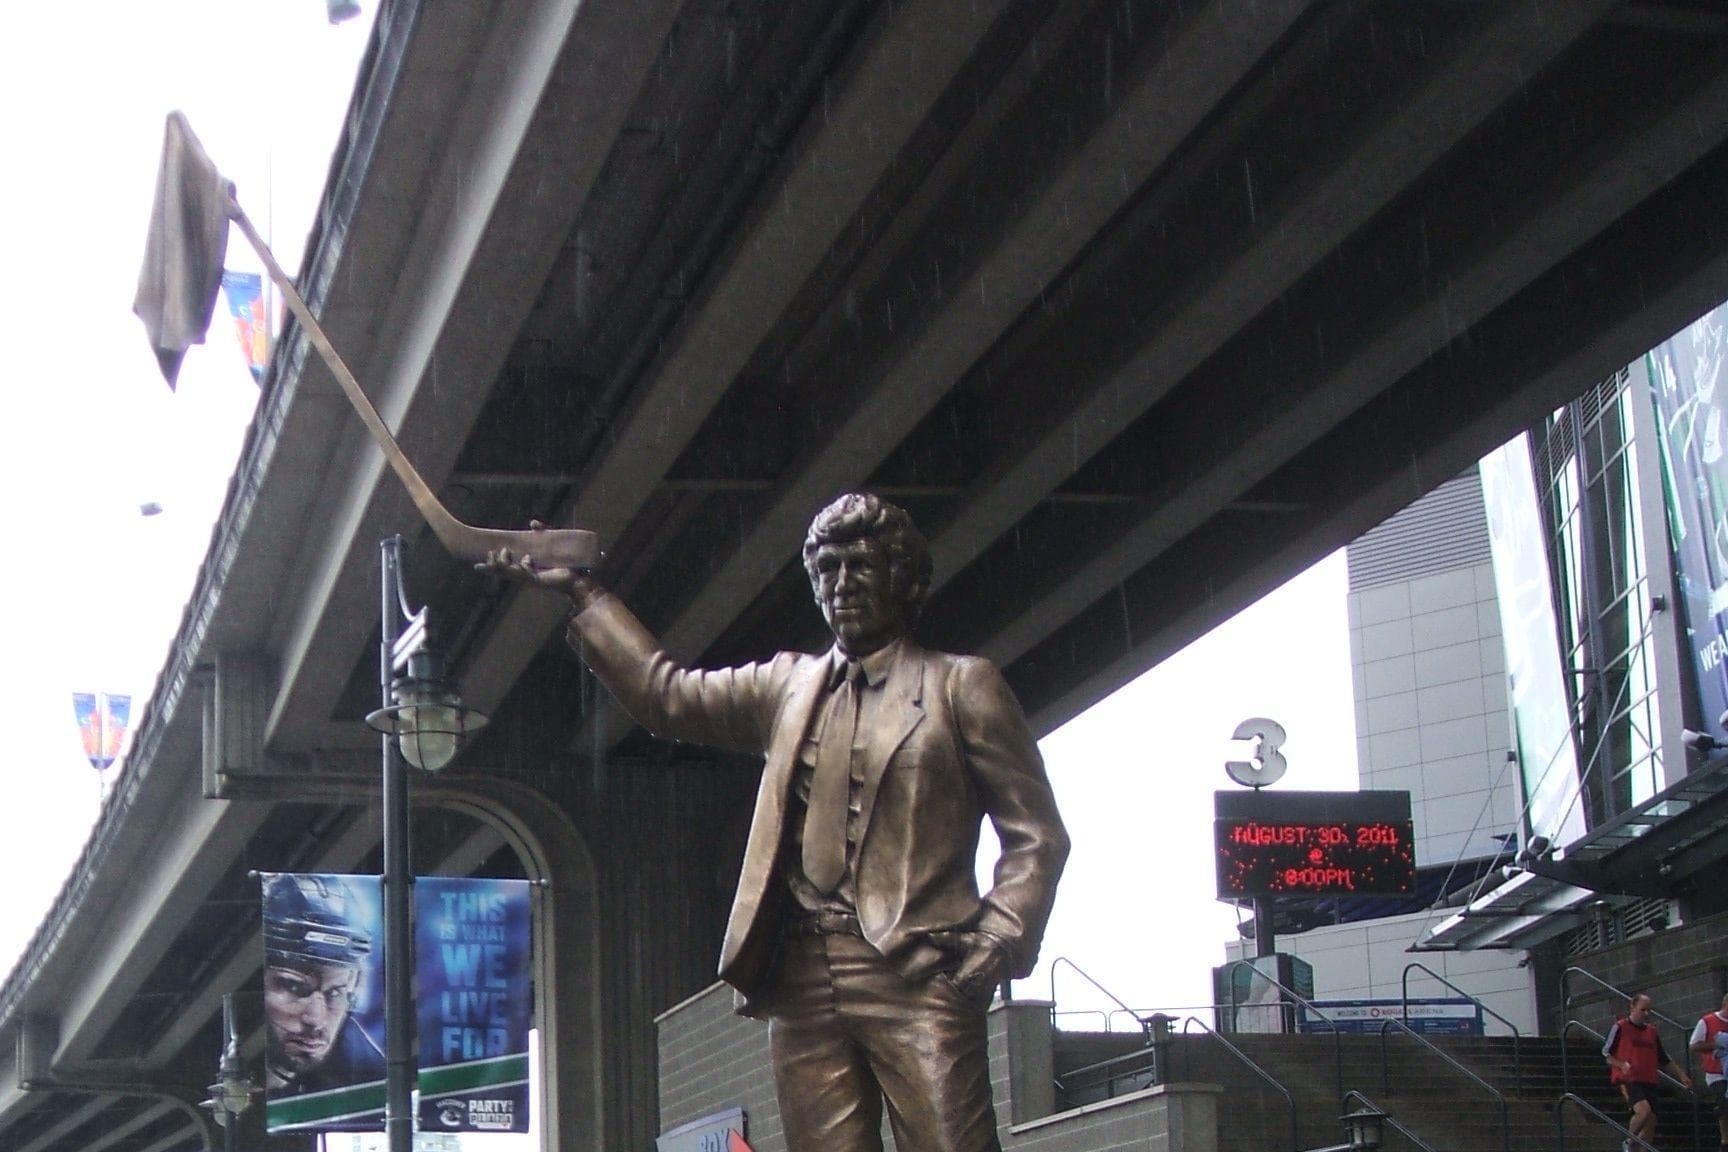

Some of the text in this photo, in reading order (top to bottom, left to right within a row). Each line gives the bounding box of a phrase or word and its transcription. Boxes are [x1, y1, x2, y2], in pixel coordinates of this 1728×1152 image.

[1225, 717, 1287, 788] 3
[1234, 826, 1308, 845] AUGUST
[1357, 827, 1398, 845] 2011
[440, 893, 507, 922] THIS
[462, 923, 505, 941] WHAT
[442, 943, 507, 988] WE
[440, 991, 508, 1024] LIVE
[442, 1027, 508, 1062] FOR
[469, 1100, 507, 1112] PARTY
